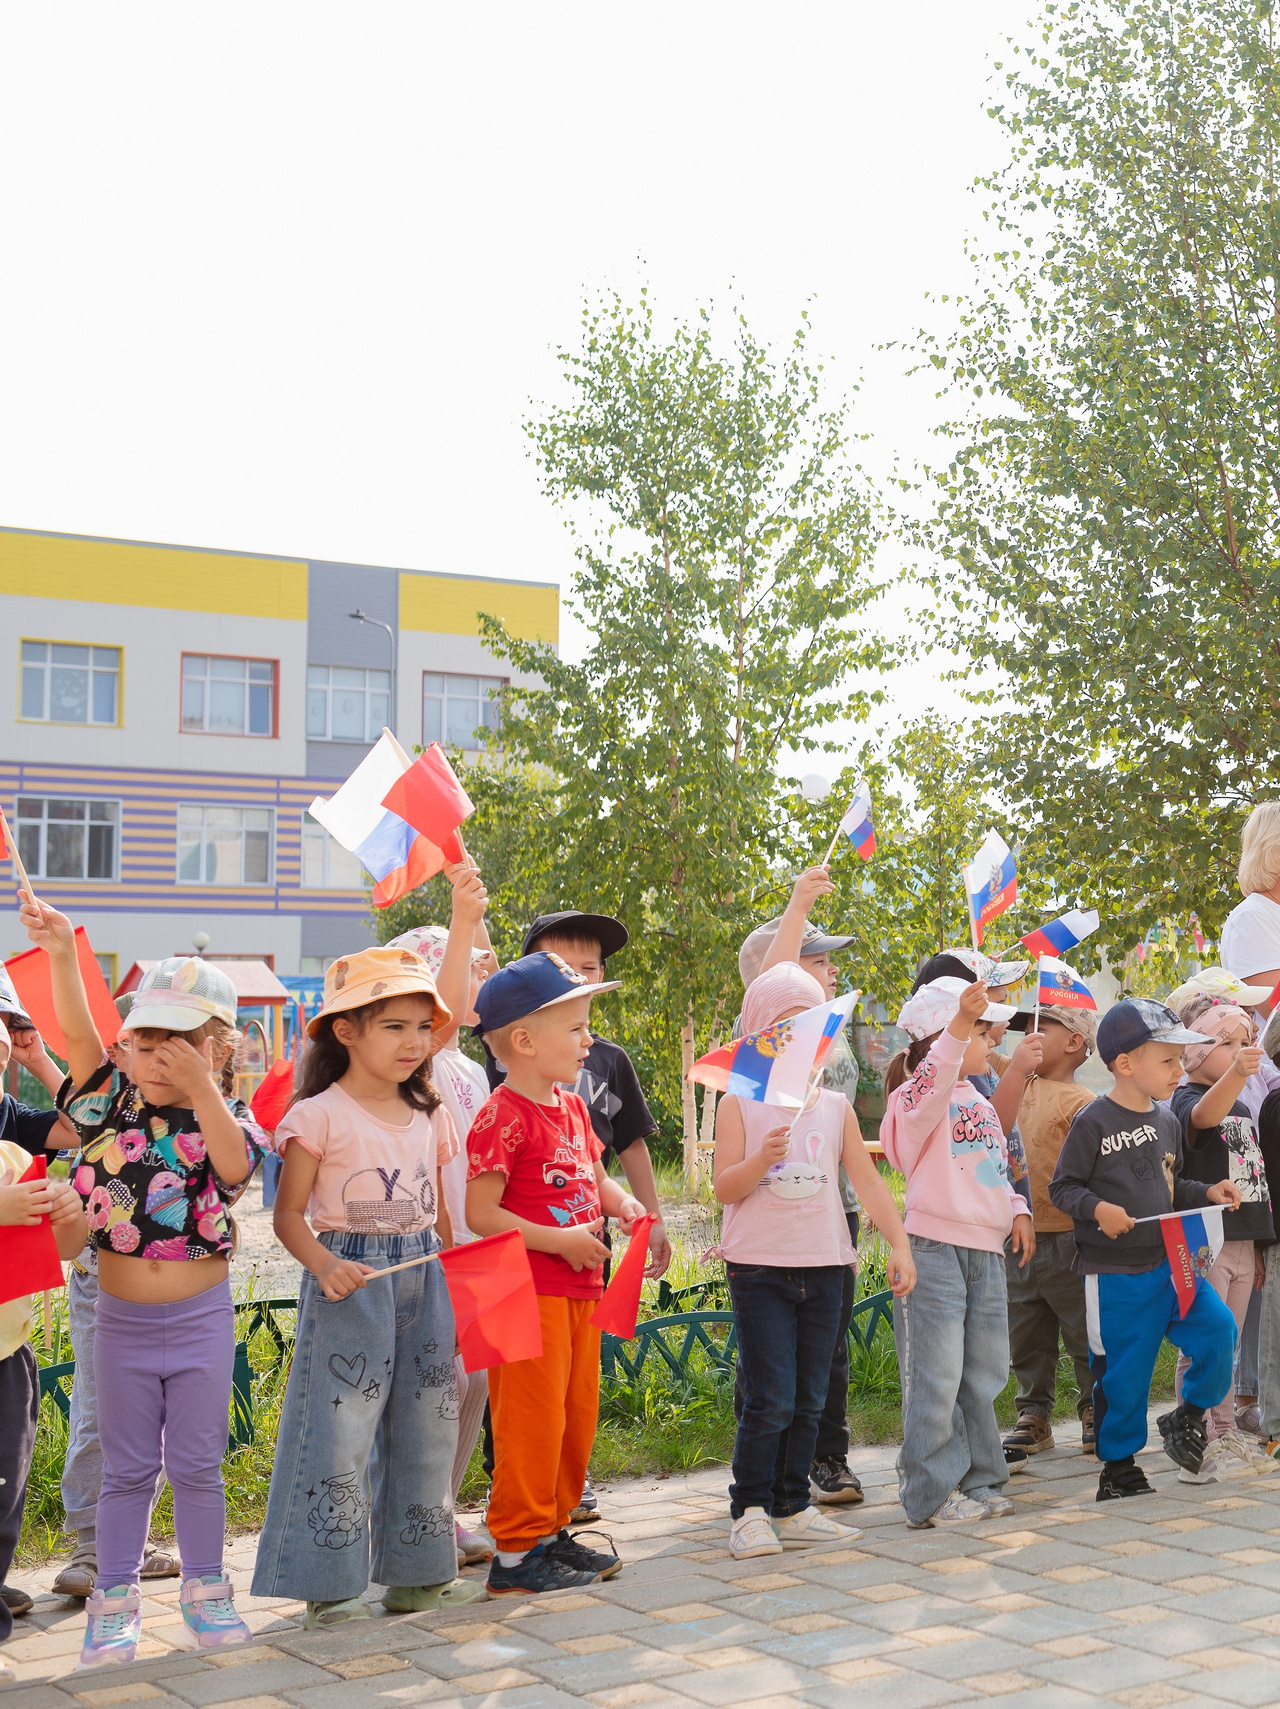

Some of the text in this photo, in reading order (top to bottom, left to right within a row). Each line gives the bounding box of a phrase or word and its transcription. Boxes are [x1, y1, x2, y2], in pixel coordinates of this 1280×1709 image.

[1050, 989, 1079, 1000] РОССИЯ
[1101, 1124, 1159, 1156] SUPER
[1177, 1244, 1193, 1289] РОССИЯ
